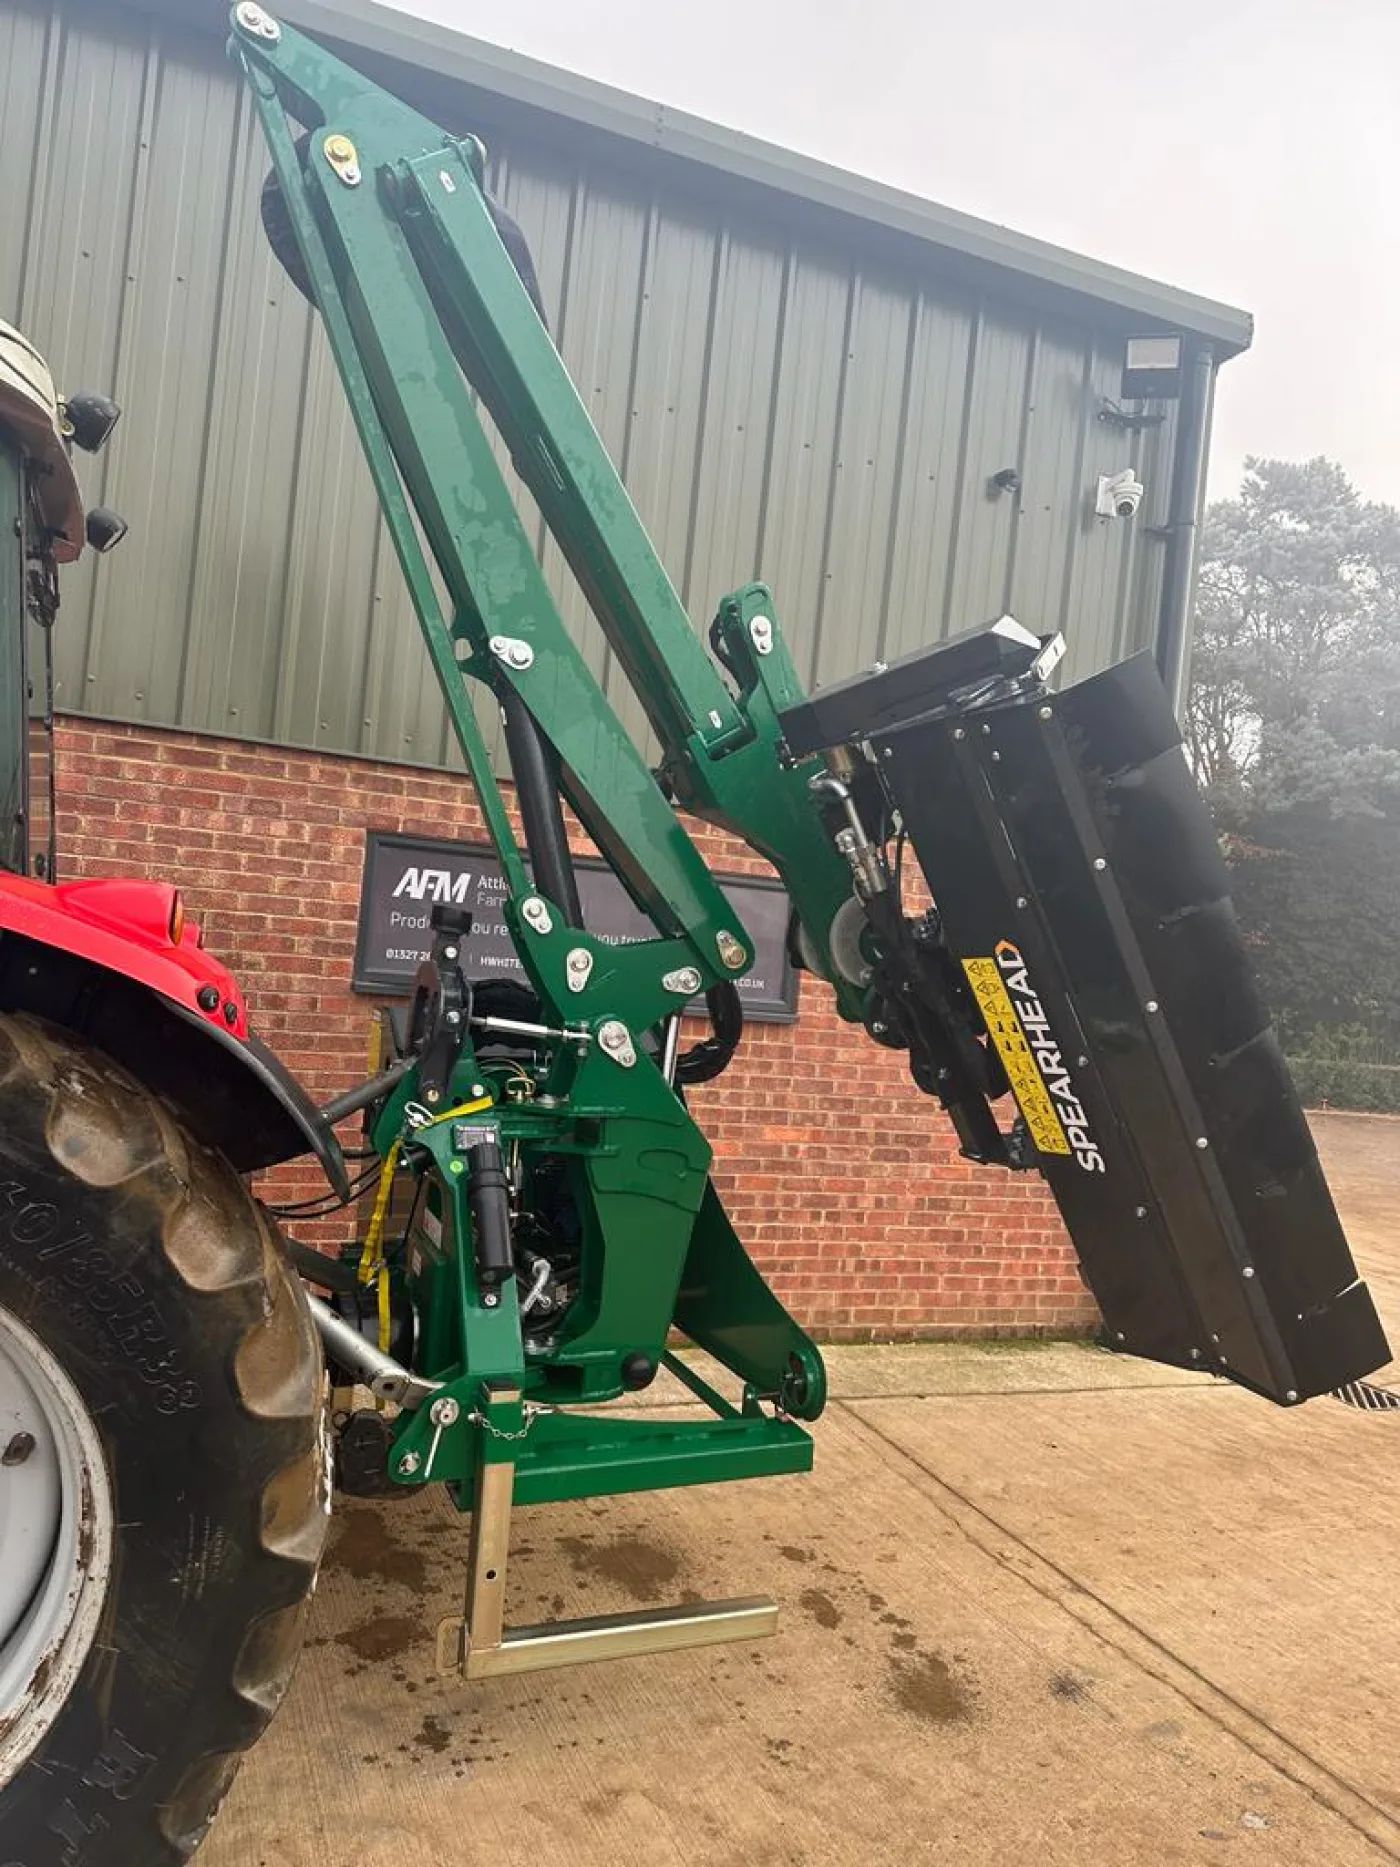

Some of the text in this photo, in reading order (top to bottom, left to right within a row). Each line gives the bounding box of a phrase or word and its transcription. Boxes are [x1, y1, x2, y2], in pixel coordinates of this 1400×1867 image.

[392, 867, 471, 903] AFM
[390, 911, 431, 929] Prod
[472, 922, 509, 935] ou re
[480, 956, 523, 969] HWHITE
[993, 938, 1106, 1173] SPEARHEAD
